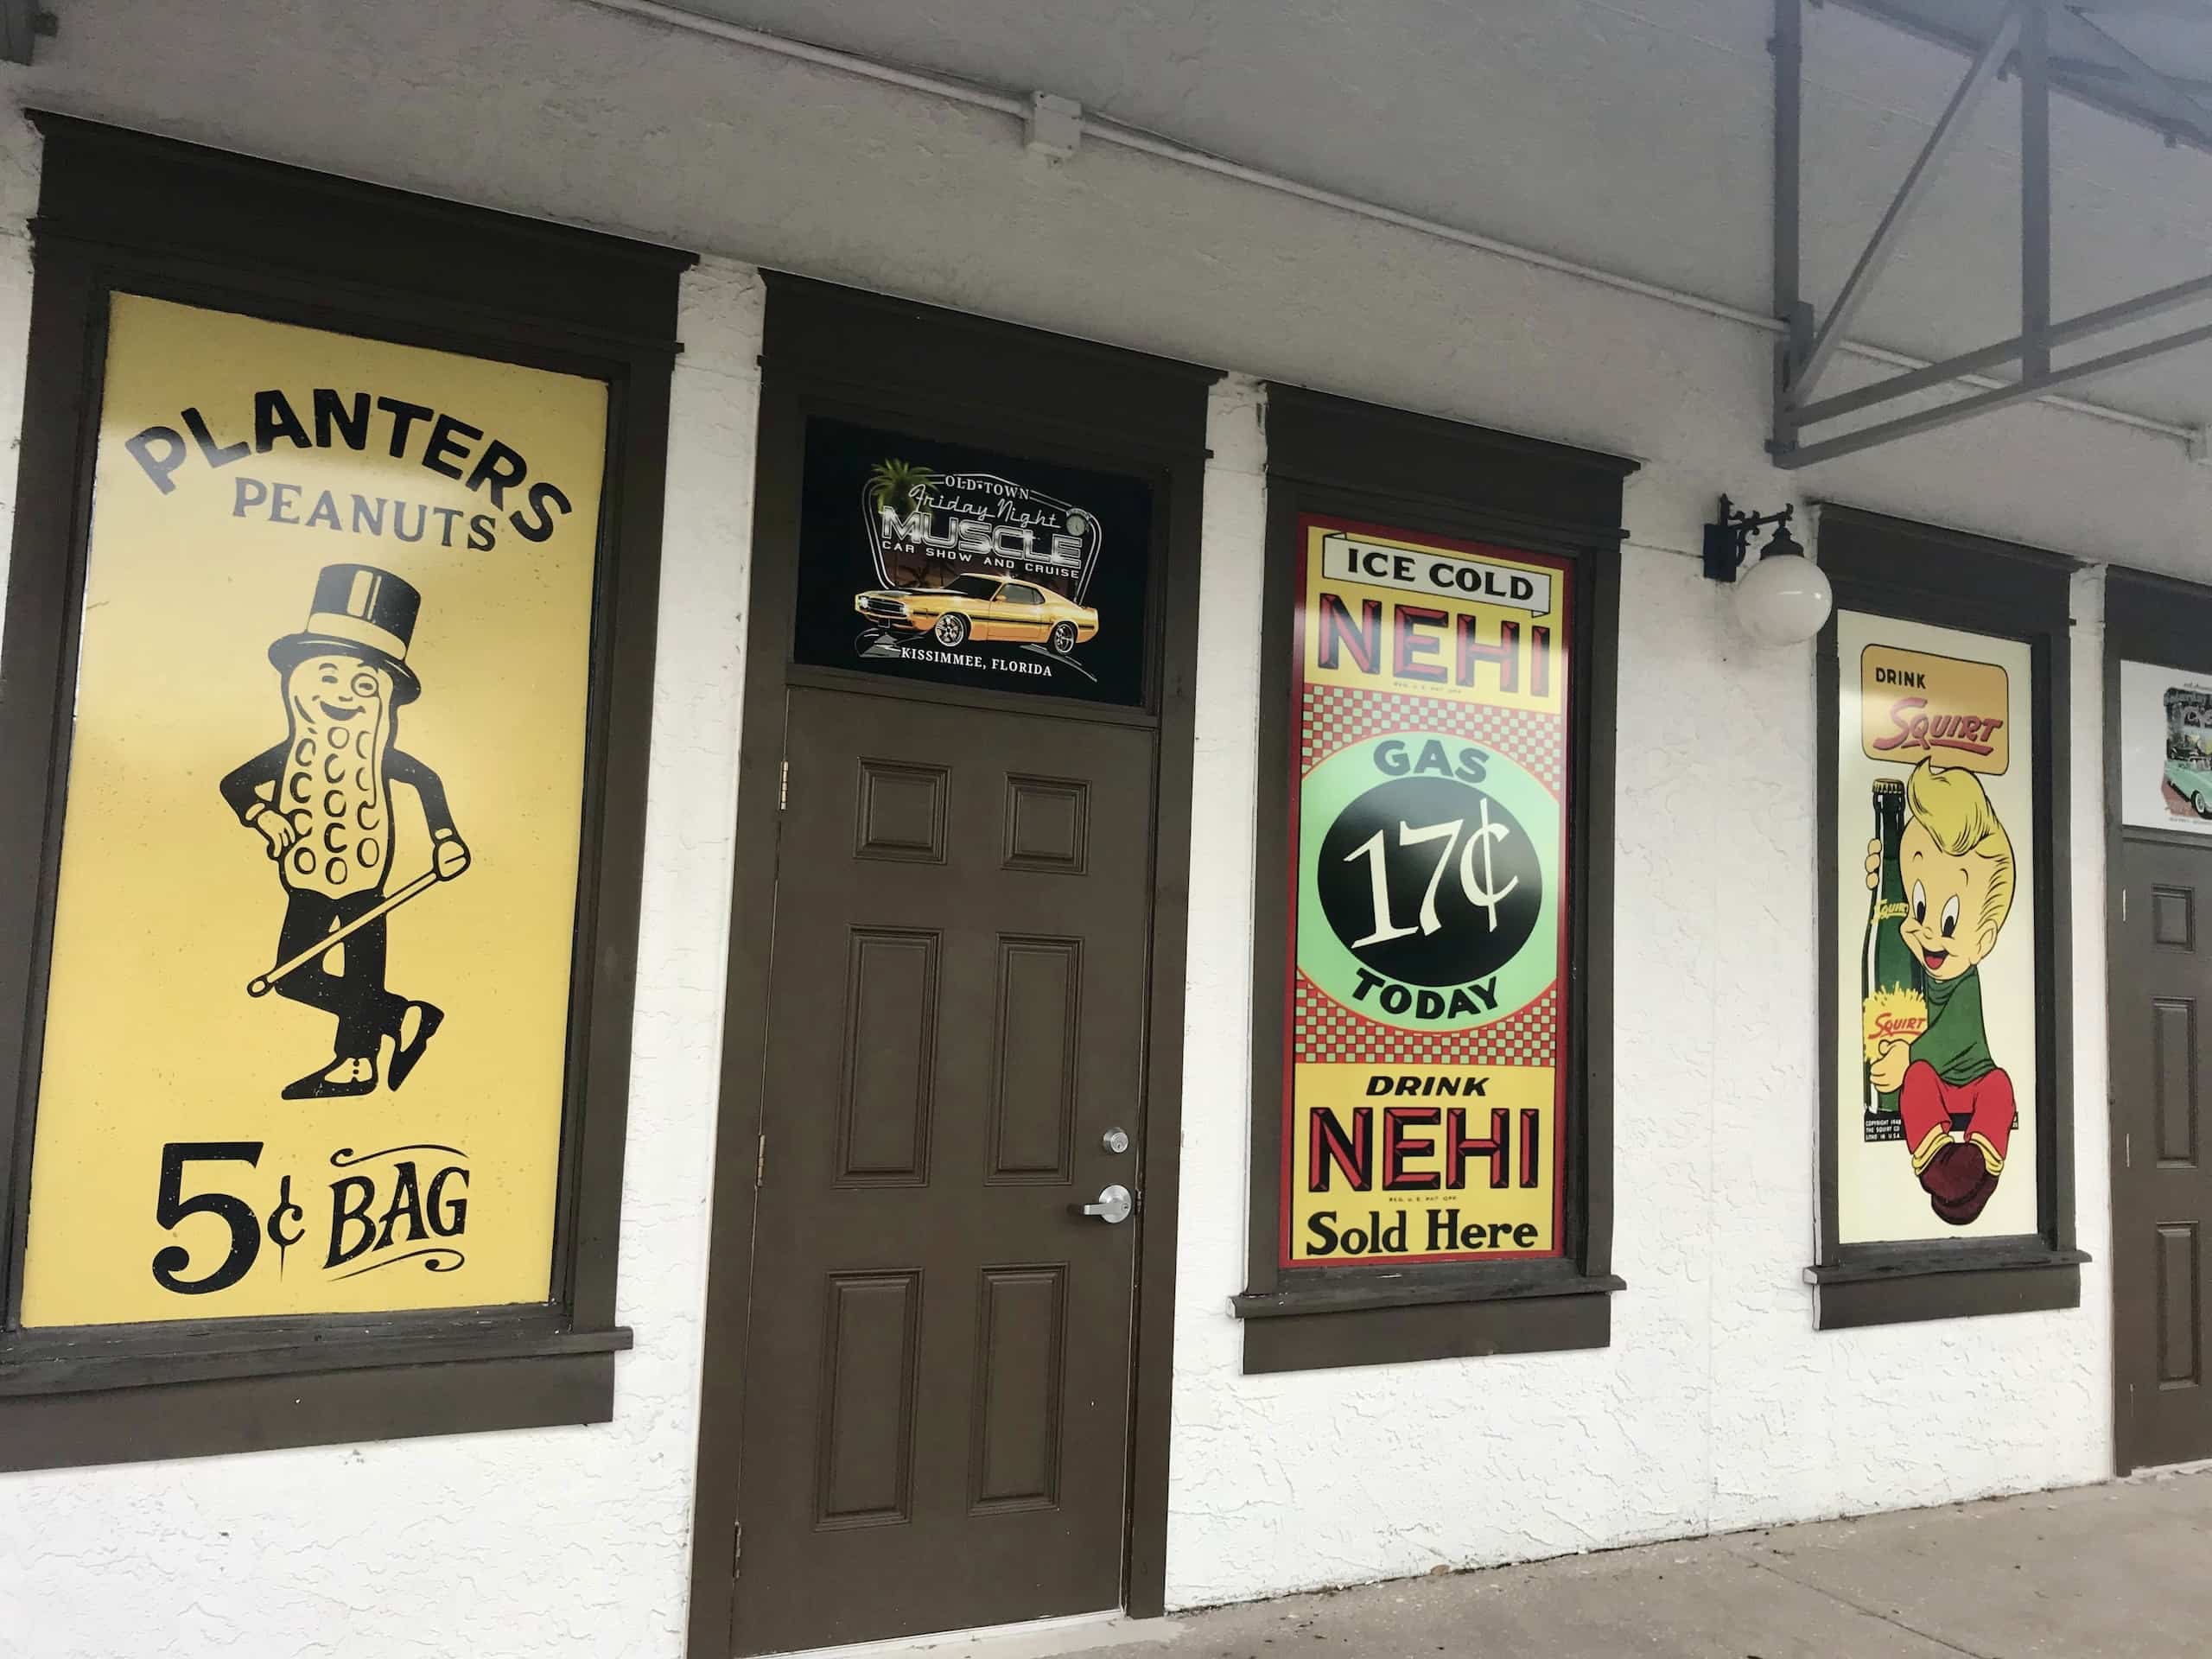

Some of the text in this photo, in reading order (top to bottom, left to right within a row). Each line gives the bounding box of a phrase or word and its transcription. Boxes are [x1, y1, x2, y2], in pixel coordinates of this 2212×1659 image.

[125, 389, 572, 542] PLANTERS
[985, 482, 1030, 499] TOWN
[232, 477, 496, 551] PEANUTS
[909, 484, 1061, 528] Friday Night
[882, 505, 1083, 569] MUSCLE
[882, 542, 1079, 578] CAR SHOW AND CRUISE
[1348, 548, 1534, 601] ICE COLD
[901, 648, 1052, 677] KISSIMMEE, FLORIDA
[1318, 592, 1550, 697] NEHI
[1875, 666, 1926, 689] DRINK
[1872, 697, 2003, 752] SQUIRT
[1373, 739, 1490, 784] GAS
[1343, 798, 1519, 949] 17¢
[1351, 967, 1498, 1020] TODAY
[1868, 1012, 1926, 1039] SQUIRT
[1366, 1076, 1490, 1096] DRINK
[1308, 1107, 1539, 1192] NEHI
[153, 1141, 470, 1294] 5¢ BAG
[1306, 1209, 1538, 1255] Sold Here
